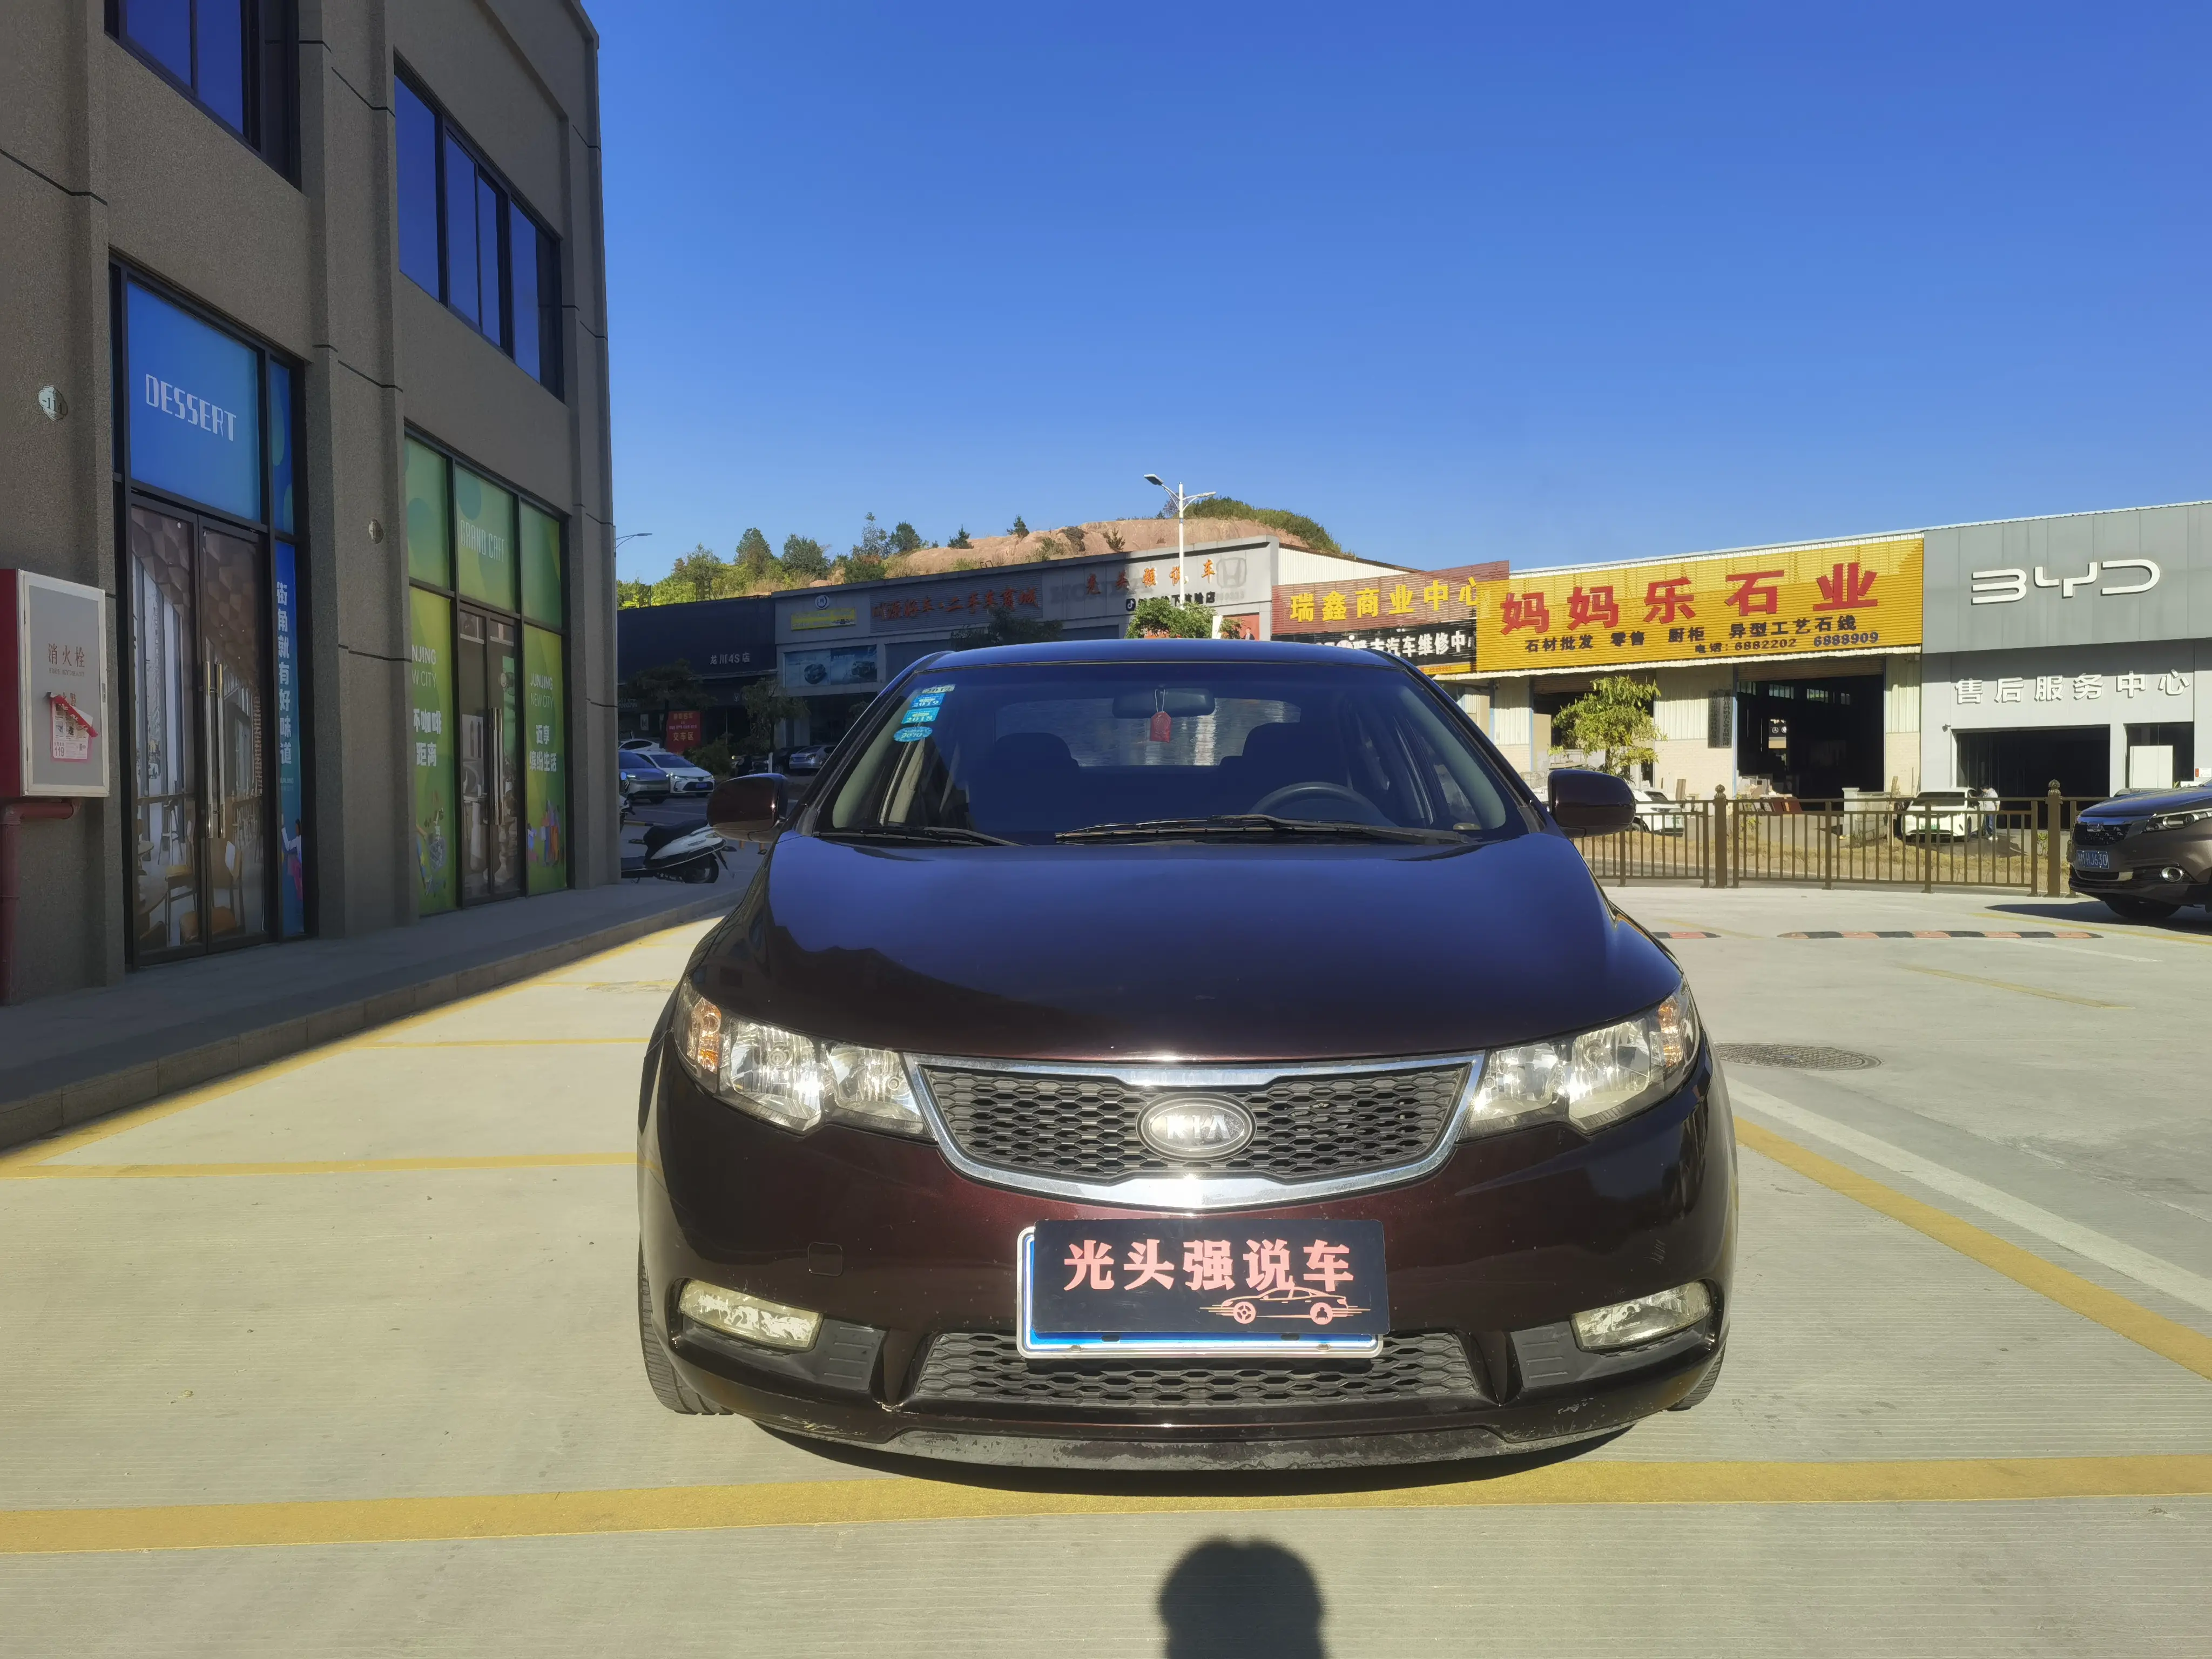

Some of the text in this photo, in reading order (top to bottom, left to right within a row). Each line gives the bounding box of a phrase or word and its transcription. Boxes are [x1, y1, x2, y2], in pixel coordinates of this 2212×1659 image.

[146, 374, 236, 441] DESSERT
[461, 520, 486, 555] GRAND
[1290, 576, 1478, 622] 瑞鑫商业中心
[1500, 561, 1879, 635] 妈妈乐石业
[1971, 559, 2161, 605] BYD
[1525, 634, 1594, 653] 石材批发
[1610, 631, 1645, 647] 零售
[1729, 615, 1857, 639] 异型工艺石线
[1813, 631, 1879, 647] 6888909
[48, 643, 85, 667] 消火栓
[276, 581, 292, 765] 街角就有好味道
[421, 671, 436, 688] CITY
[530, 673, 553, 691] JUNJING
[1954, 669, 2191, 704] 售后服务中心
[530, 692, 554, 710] NEW CITY
[55, 746, 64, 757] 119
[529, 751, 557, 772] 缤纷生活
[1165, 1115, 1231, 1139] KIA
[1063, 1239, 1354, 1292] 光头强说车
